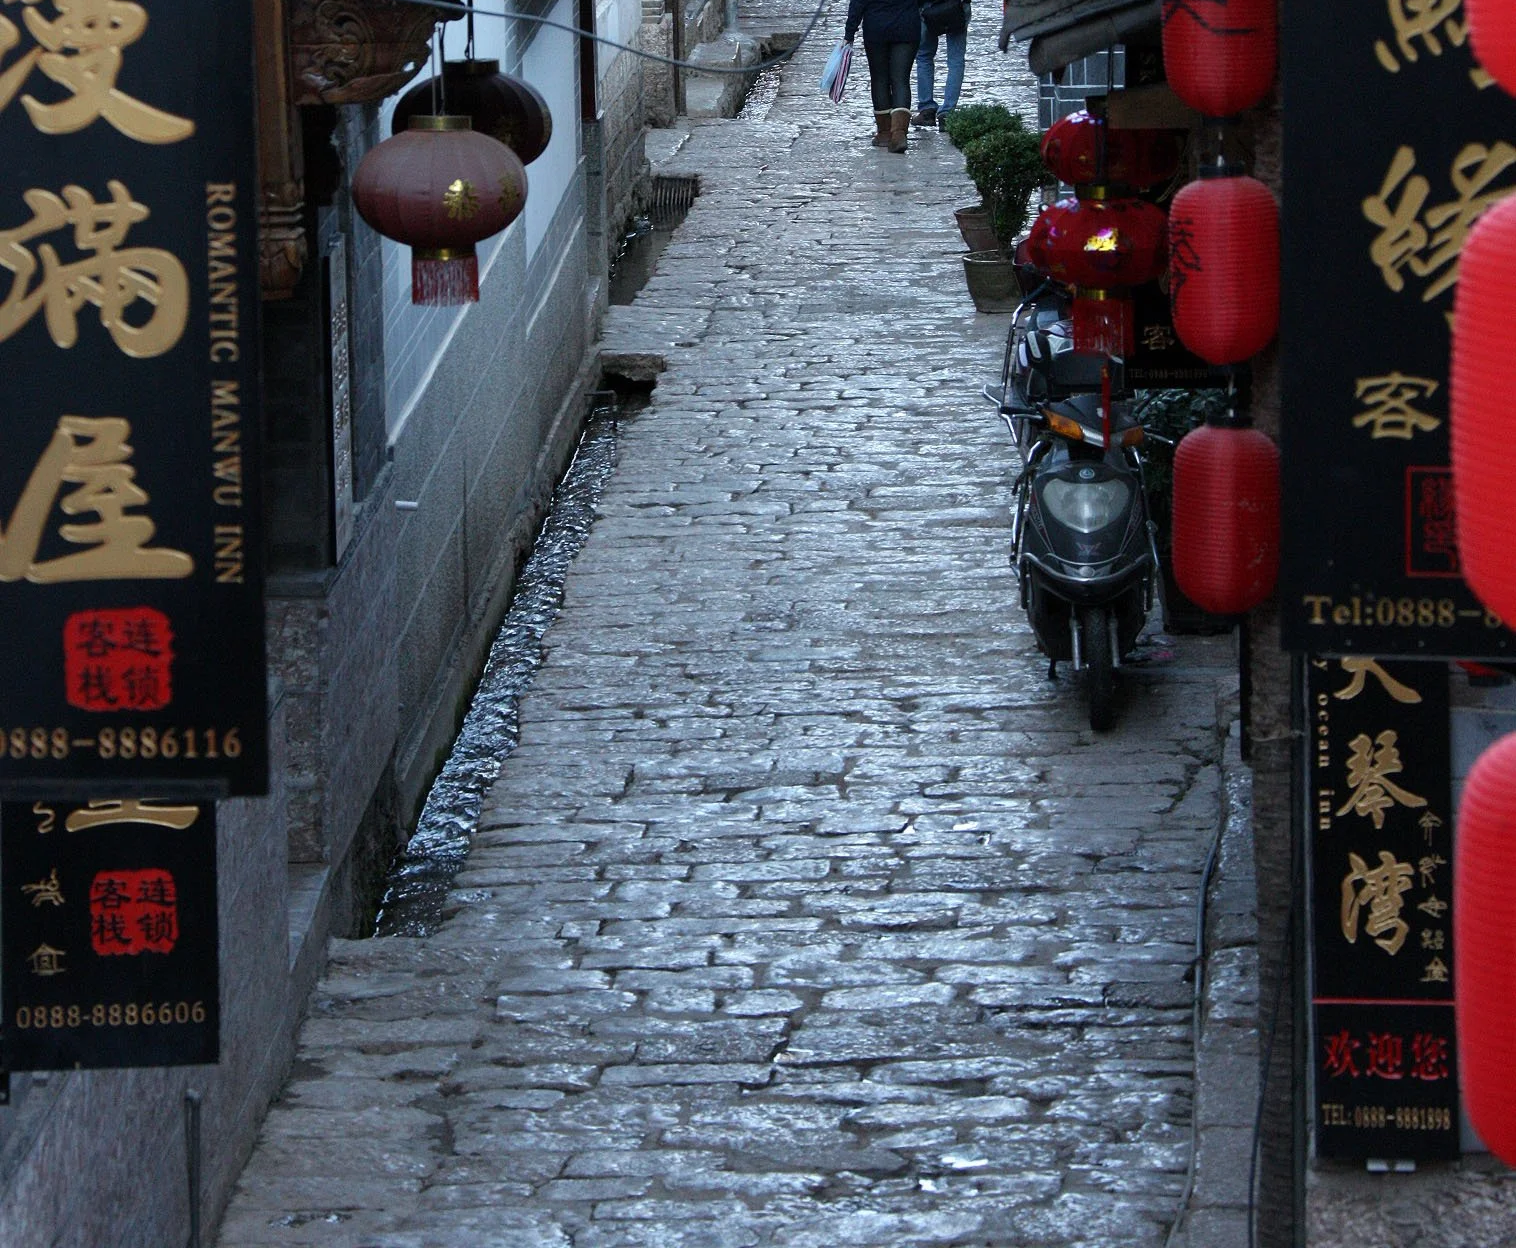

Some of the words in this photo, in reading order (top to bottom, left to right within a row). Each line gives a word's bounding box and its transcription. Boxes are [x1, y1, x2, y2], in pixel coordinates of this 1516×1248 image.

[205, 181, 241, 364] ROMANTIC
[209, 379, 244, 508] MANWU
[213, 524, 245, 585] INN
[1316, 693, 1331, 768] ocean
[1318, 789, 1336, 831] inn
[15, 1001, 207, 1029] 0888-8886606
[1323, 1027, 1449, 1081] 欢迎您
